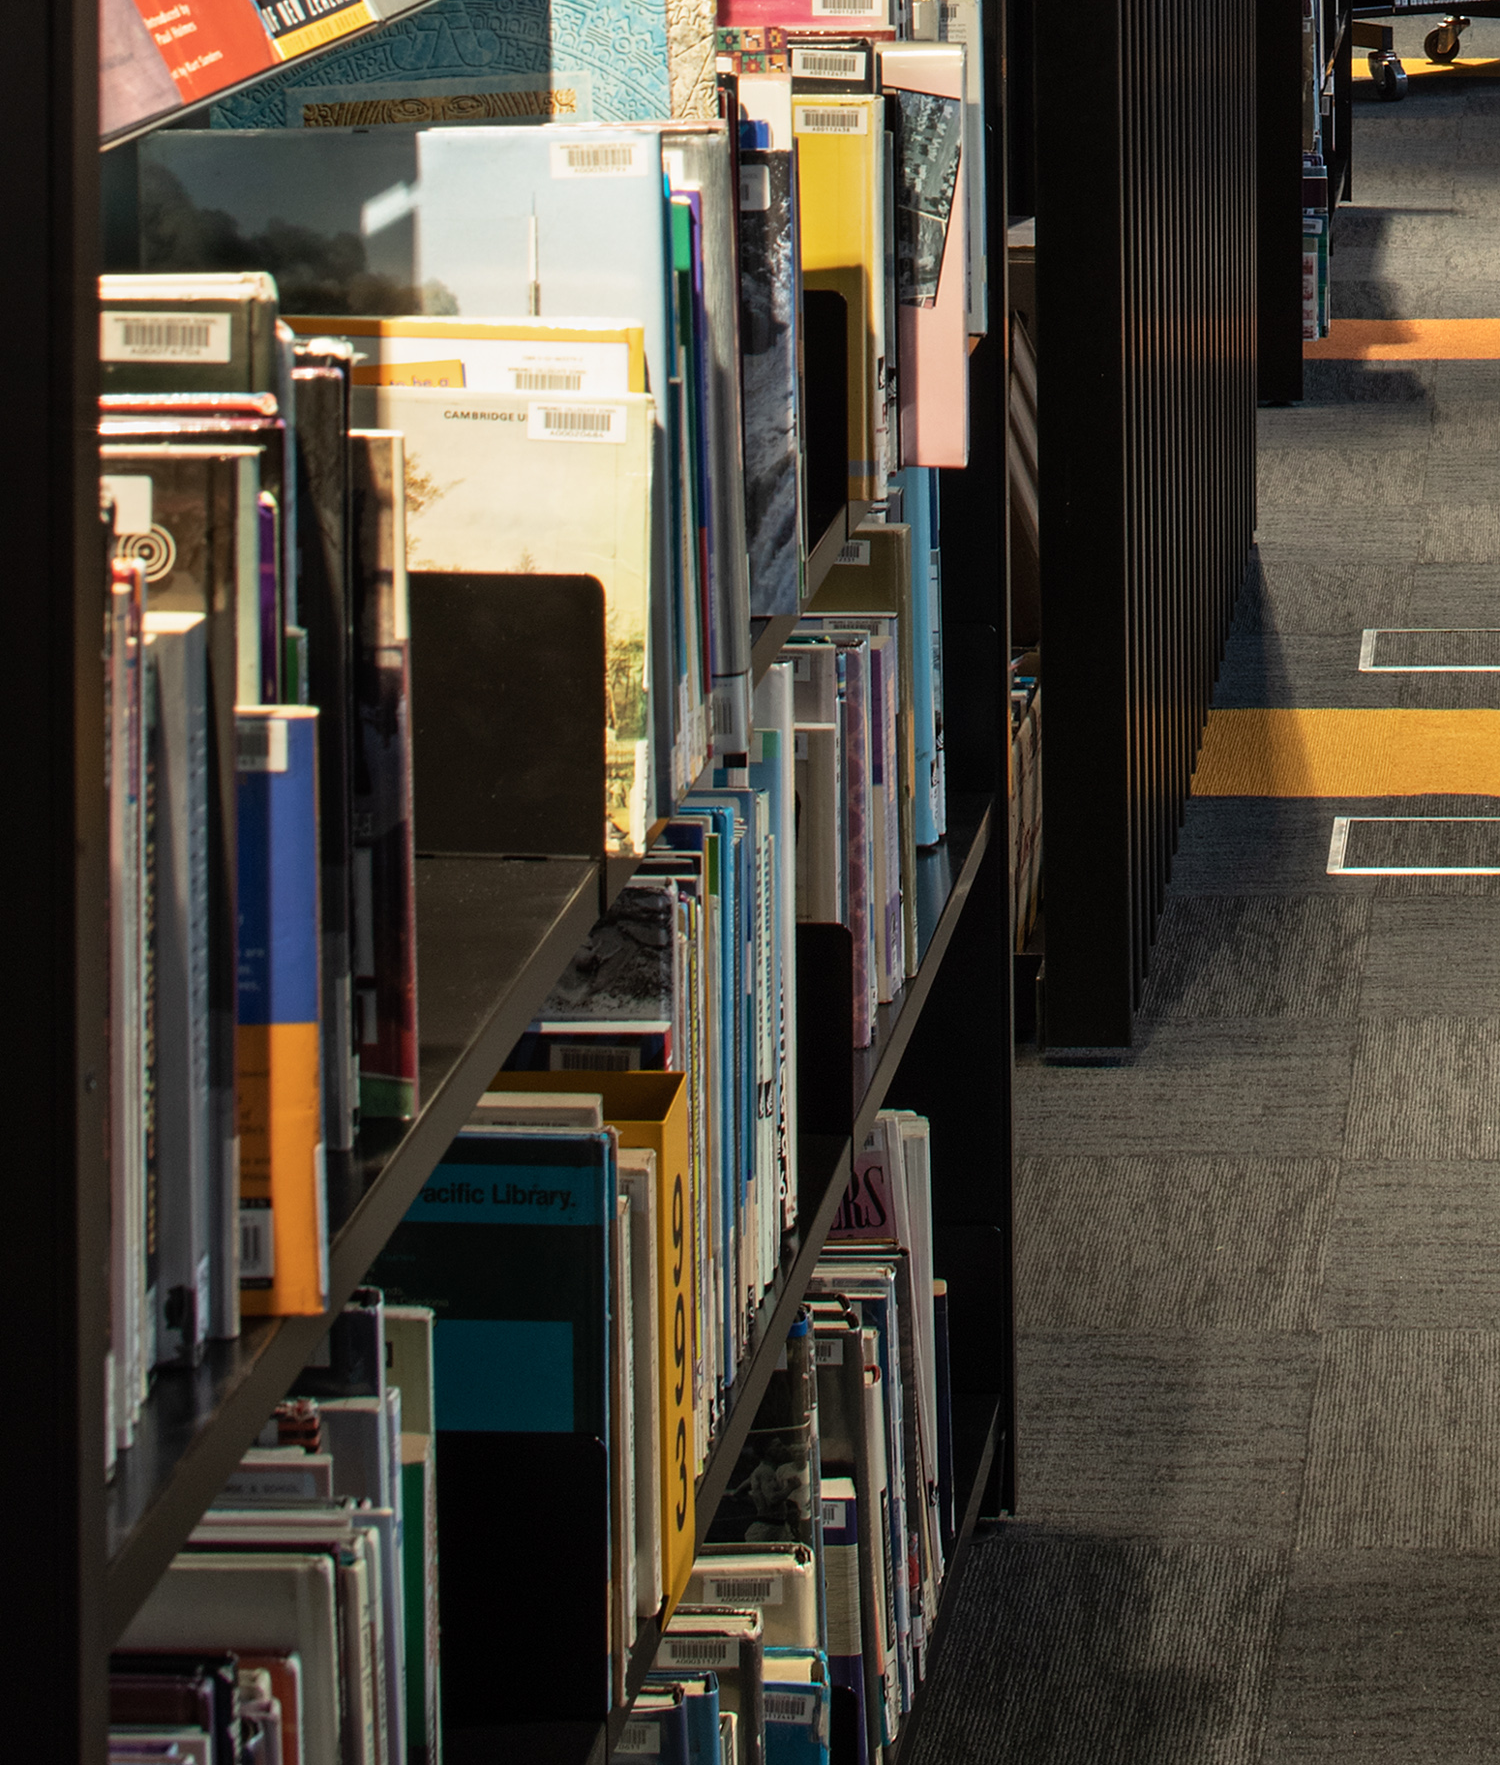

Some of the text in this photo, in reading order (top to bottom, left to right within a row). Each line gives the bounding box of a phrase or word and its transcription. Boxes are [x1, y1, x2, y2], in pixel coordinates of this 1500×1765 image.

[261, 5, 281, 33] OF
[444, 410, 514, 422] CAMBRIDGE
[492, 1183, 577, 1211] Library.
[671, 1172, 688, 1533] 993
